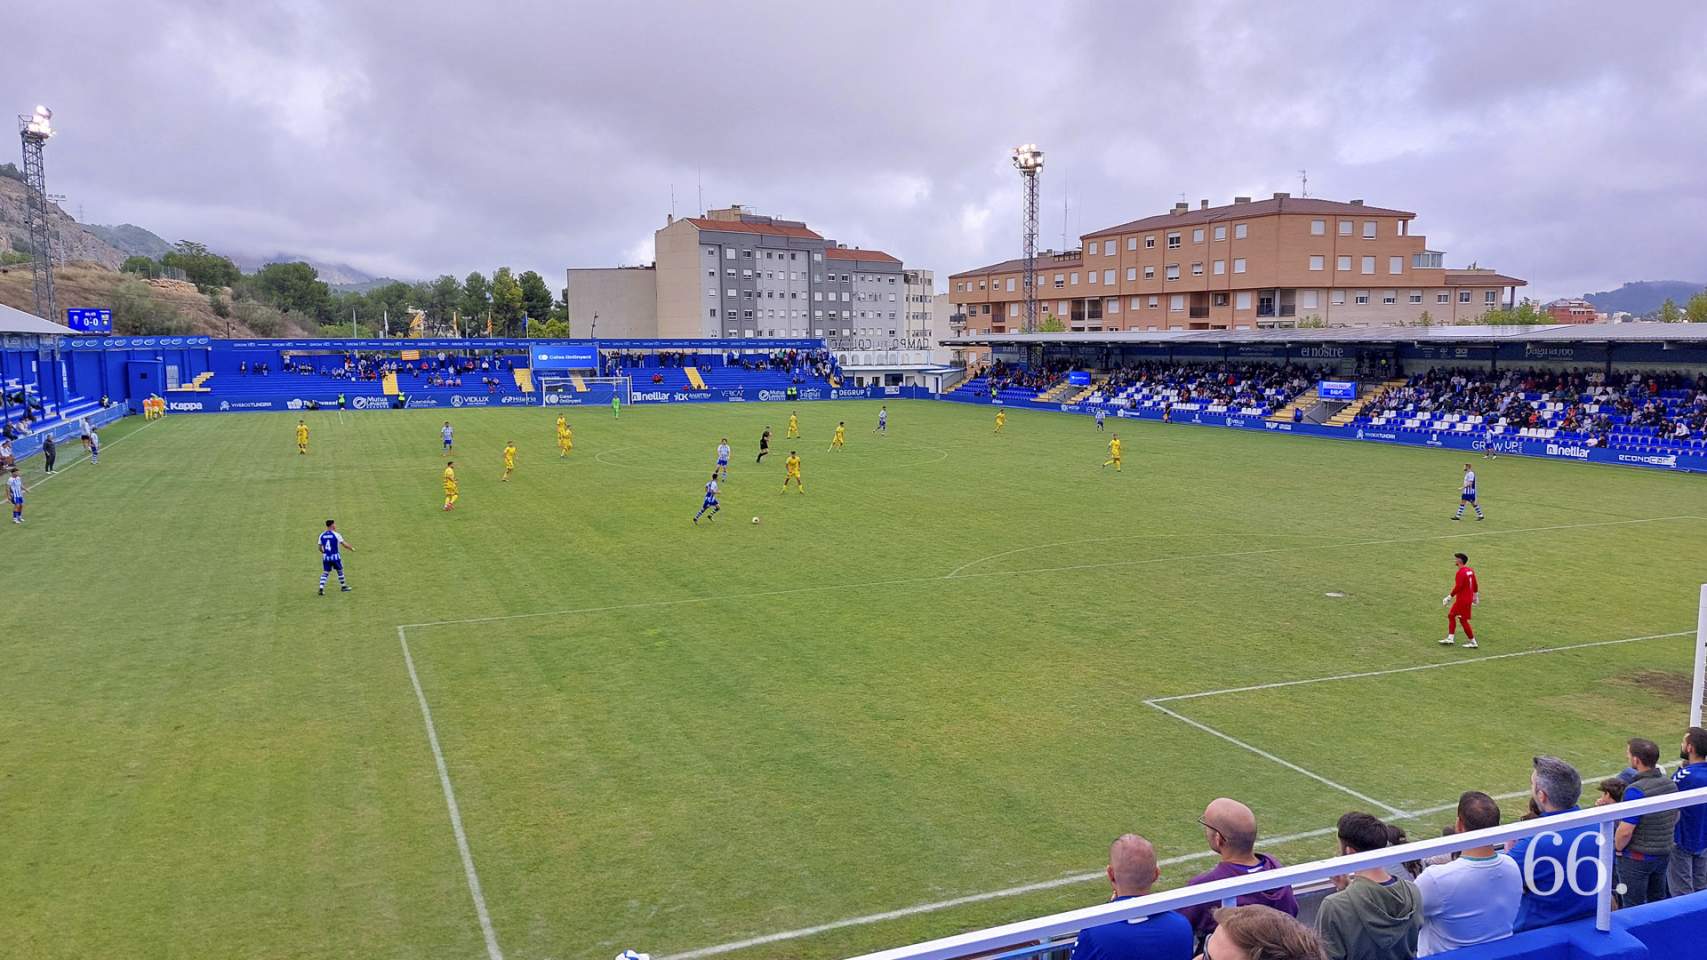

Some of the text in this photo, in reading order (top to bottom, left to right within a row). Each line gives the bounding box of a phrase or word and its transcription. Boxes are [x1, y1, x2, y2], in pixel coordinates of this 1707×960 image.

[83, 317, 99, 327] 0-0
[1471, 440, 1503, 452] GRW
[325, 539, 331, 551] 4
